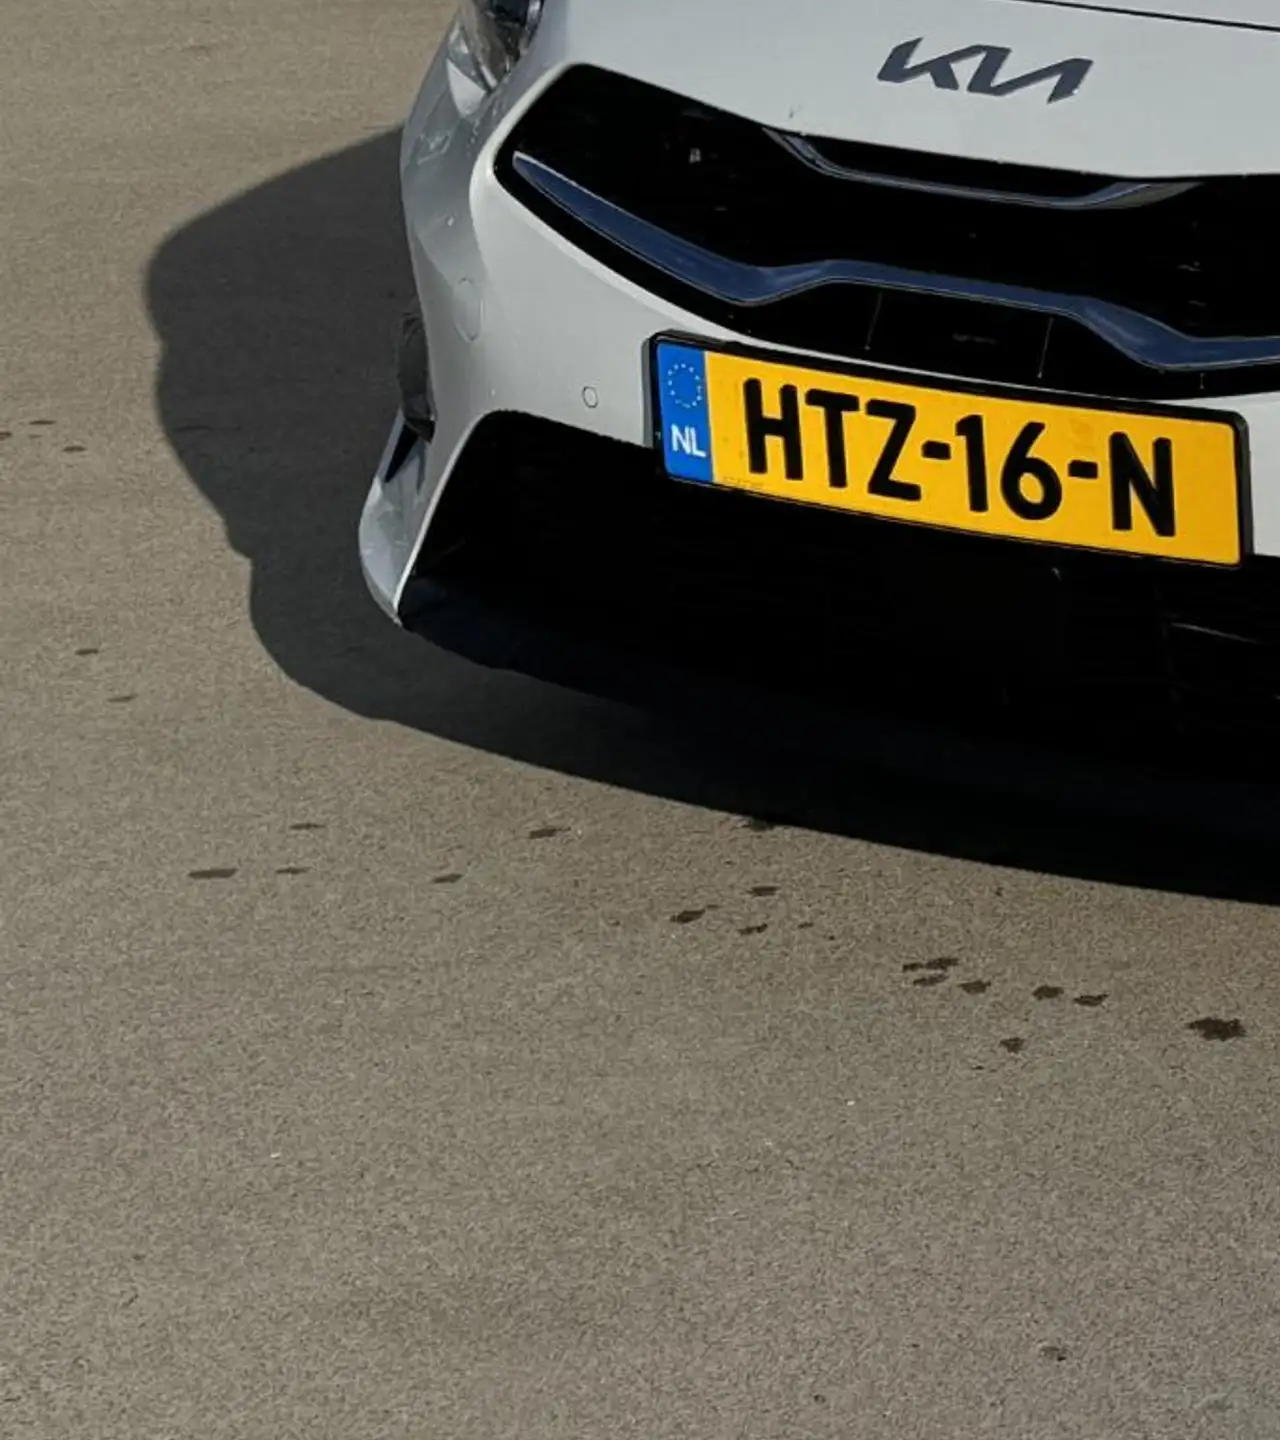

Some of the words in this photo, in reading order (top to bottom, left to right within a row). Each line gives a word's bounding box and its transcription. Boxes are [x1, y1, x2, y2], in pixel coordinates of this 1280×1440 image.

[877, 37, 1094, 104] KIA
[670, 423, 707, 458] NL
[742, 377, 1176, 538] HTZ-16-N
